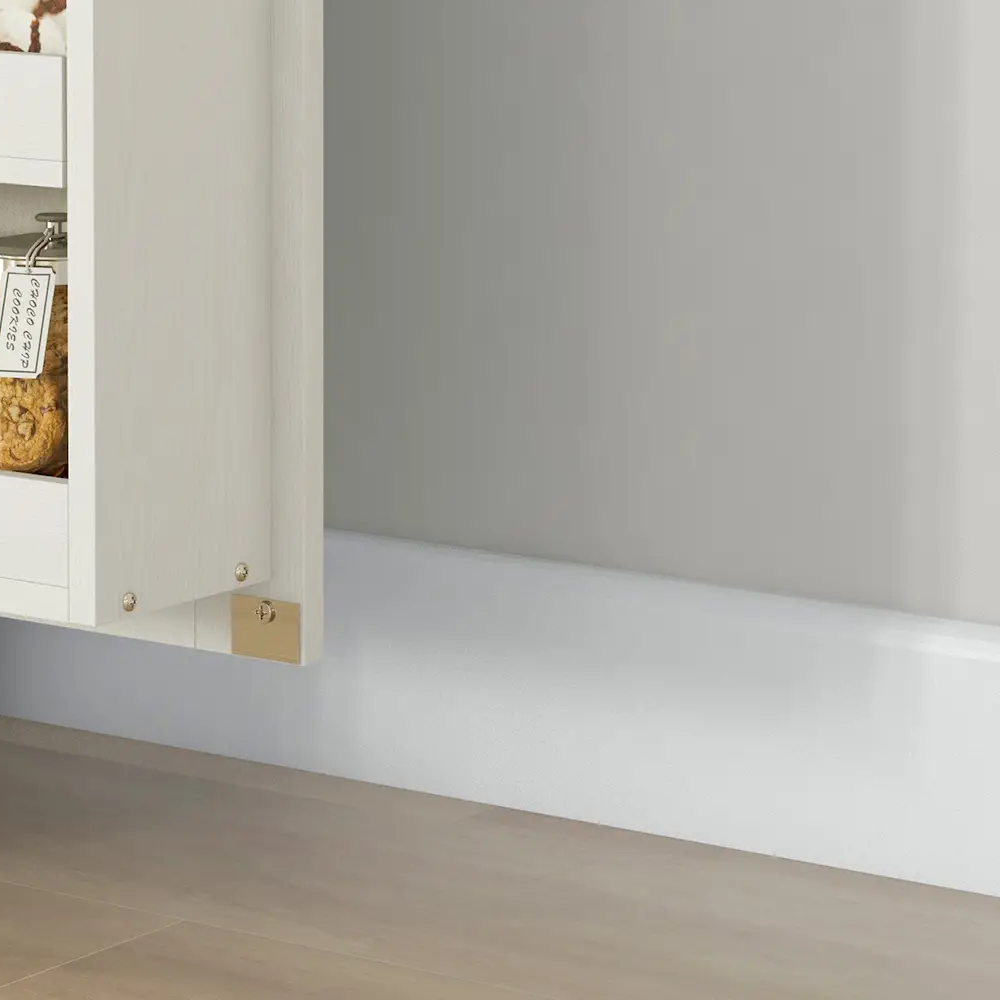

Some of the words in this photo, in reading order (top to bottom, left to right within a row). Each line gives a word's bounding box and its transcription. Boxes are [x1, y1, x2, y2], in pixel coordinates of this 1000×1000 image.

[6, 288, 22, 351] COOKIES
[26, 278, 40, 326] CHOCO
[21, 330, 33, 369] CHIP
